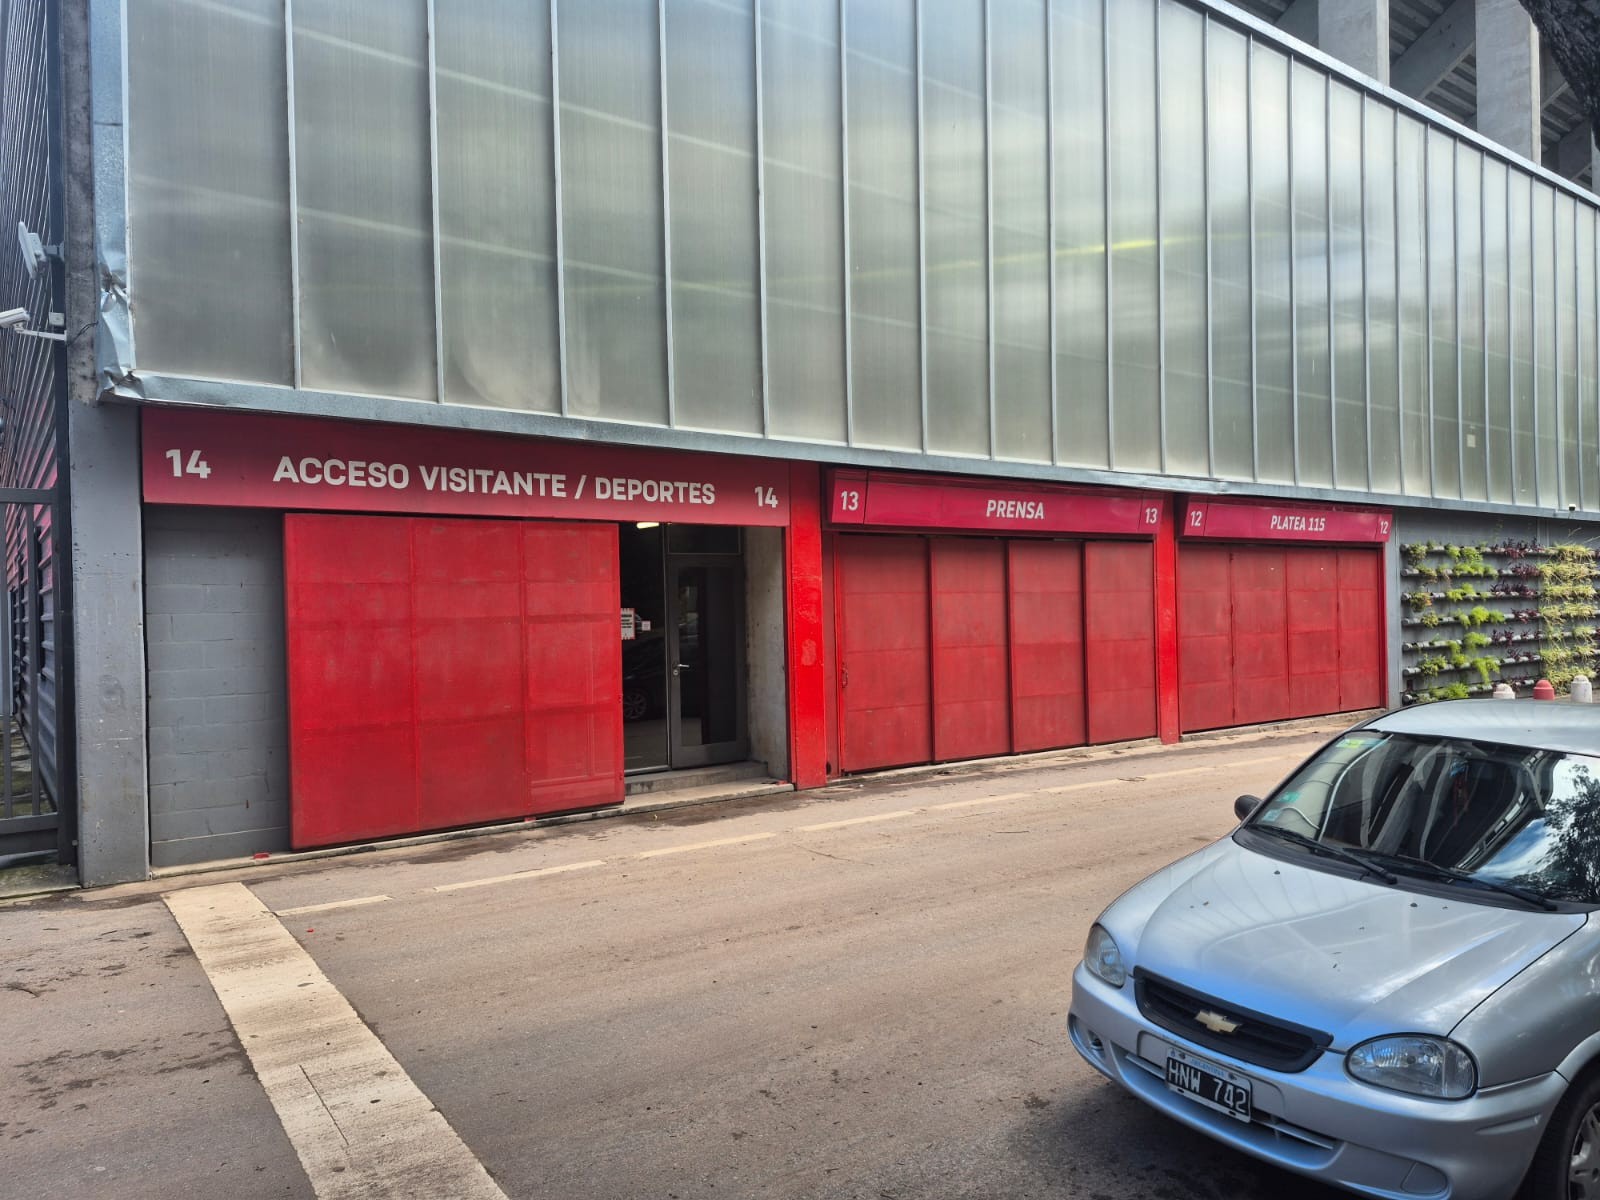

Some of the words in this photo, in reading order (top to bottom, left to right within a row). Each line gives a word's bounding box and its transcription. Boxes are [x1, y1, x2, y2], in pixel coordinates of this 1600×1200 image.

[166, 449, 212, 479] 14
[273, 456, 410, 490] ACCESO
[419, 465, 567, 498] VISITANTE
[574, 475, 587, 500] /
[595, 478, 716, 505] DEPORTES
[754, 486, 779, 509] 14
[841, 490, 859, 511] 13
[986, 499, 1045, 520] PRENSA
[1145, 507, 1158, 525] 13
[1190, 510, 1203, 528] 12
[1270, 515, 1306, 531] PLATEA
[1308, 517, 1326, 532] 115
[1380, 521, 1389, 535] 12
[1168, 1059, 1201, 1094] HNW
[1213, 1078, 1247, 1113] 742
